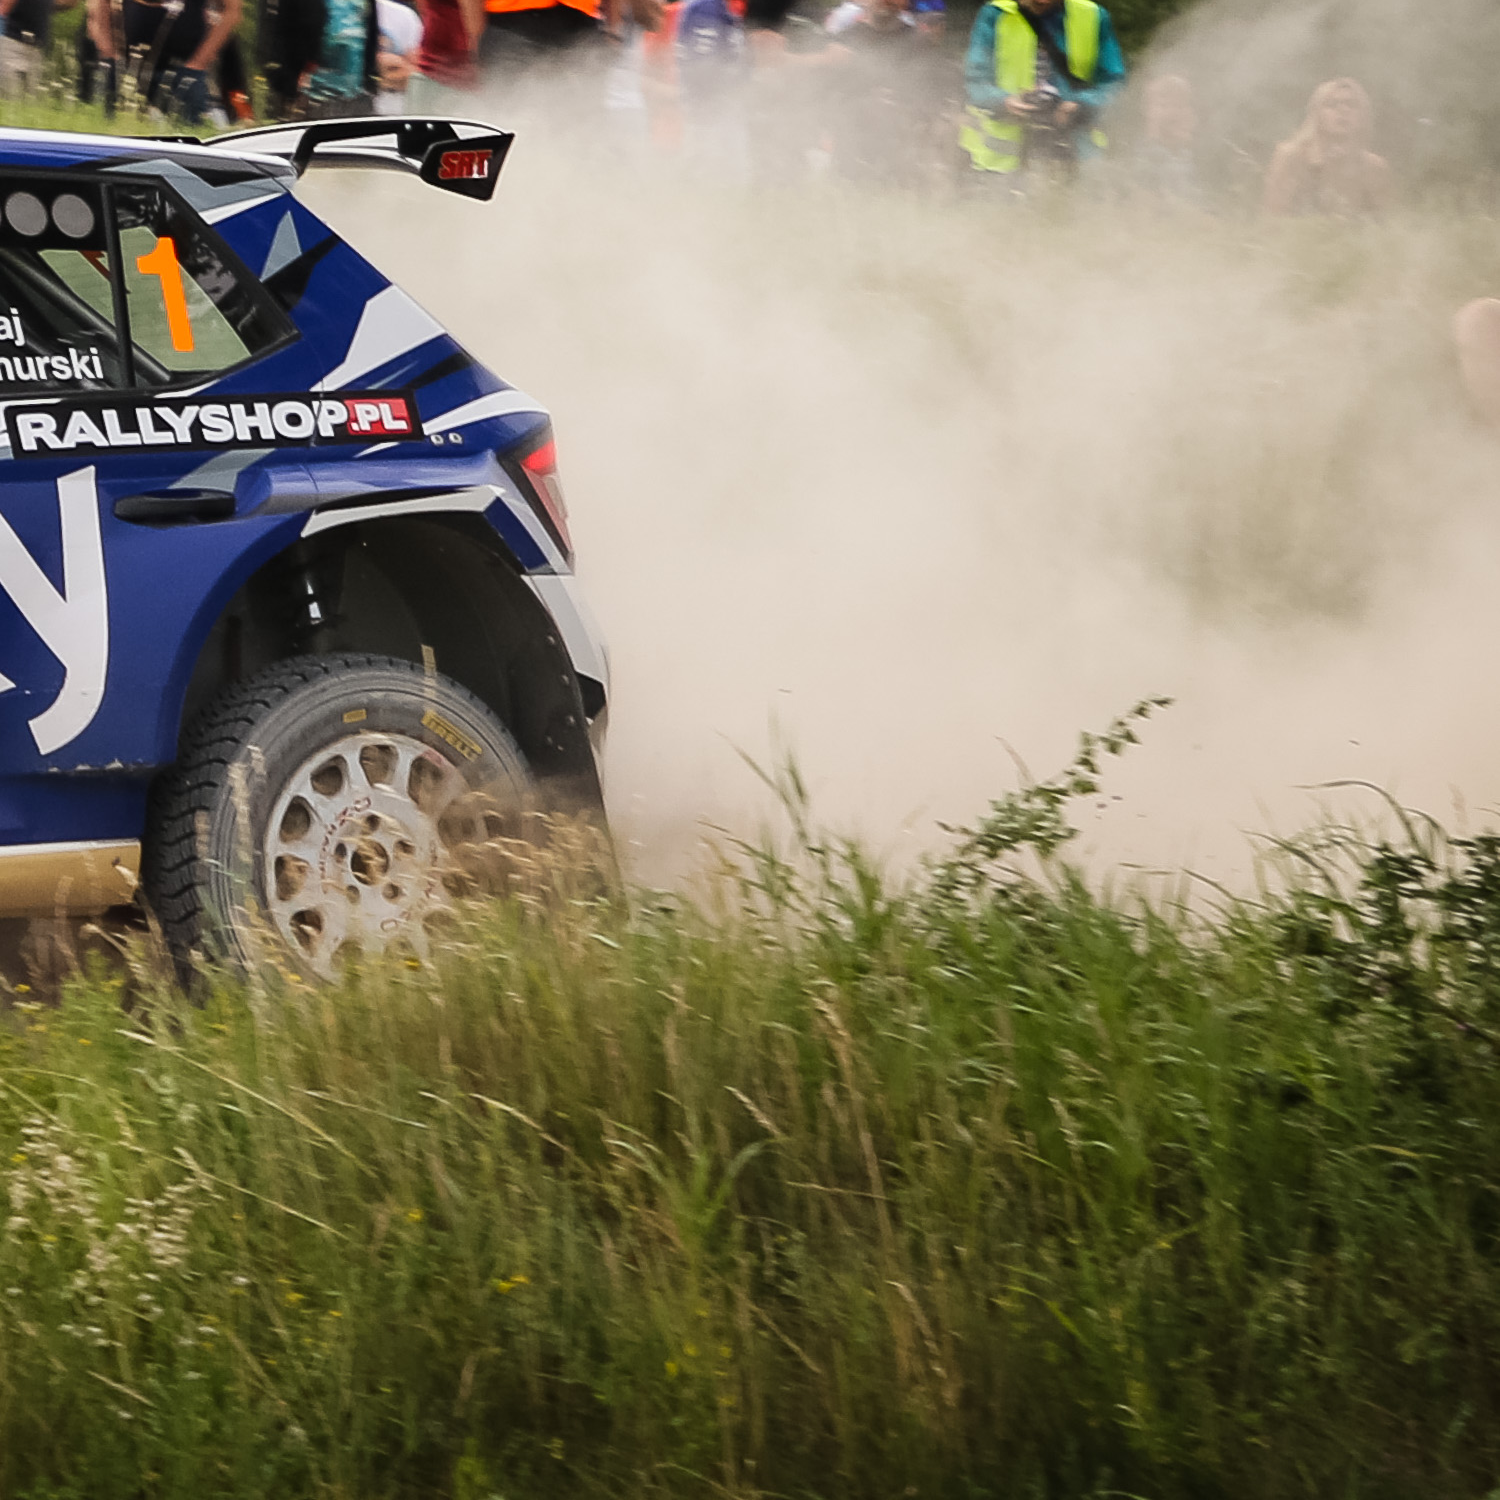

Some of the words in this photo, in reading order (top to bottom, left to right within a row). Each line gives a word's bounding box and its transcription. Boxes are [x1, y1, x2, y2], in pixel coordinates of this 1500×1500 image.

[438, 149, 493, 179] SRT
[136, 236, 195, 352] 1
[16, 397, 408, 451] RALLYSHOP.PL
